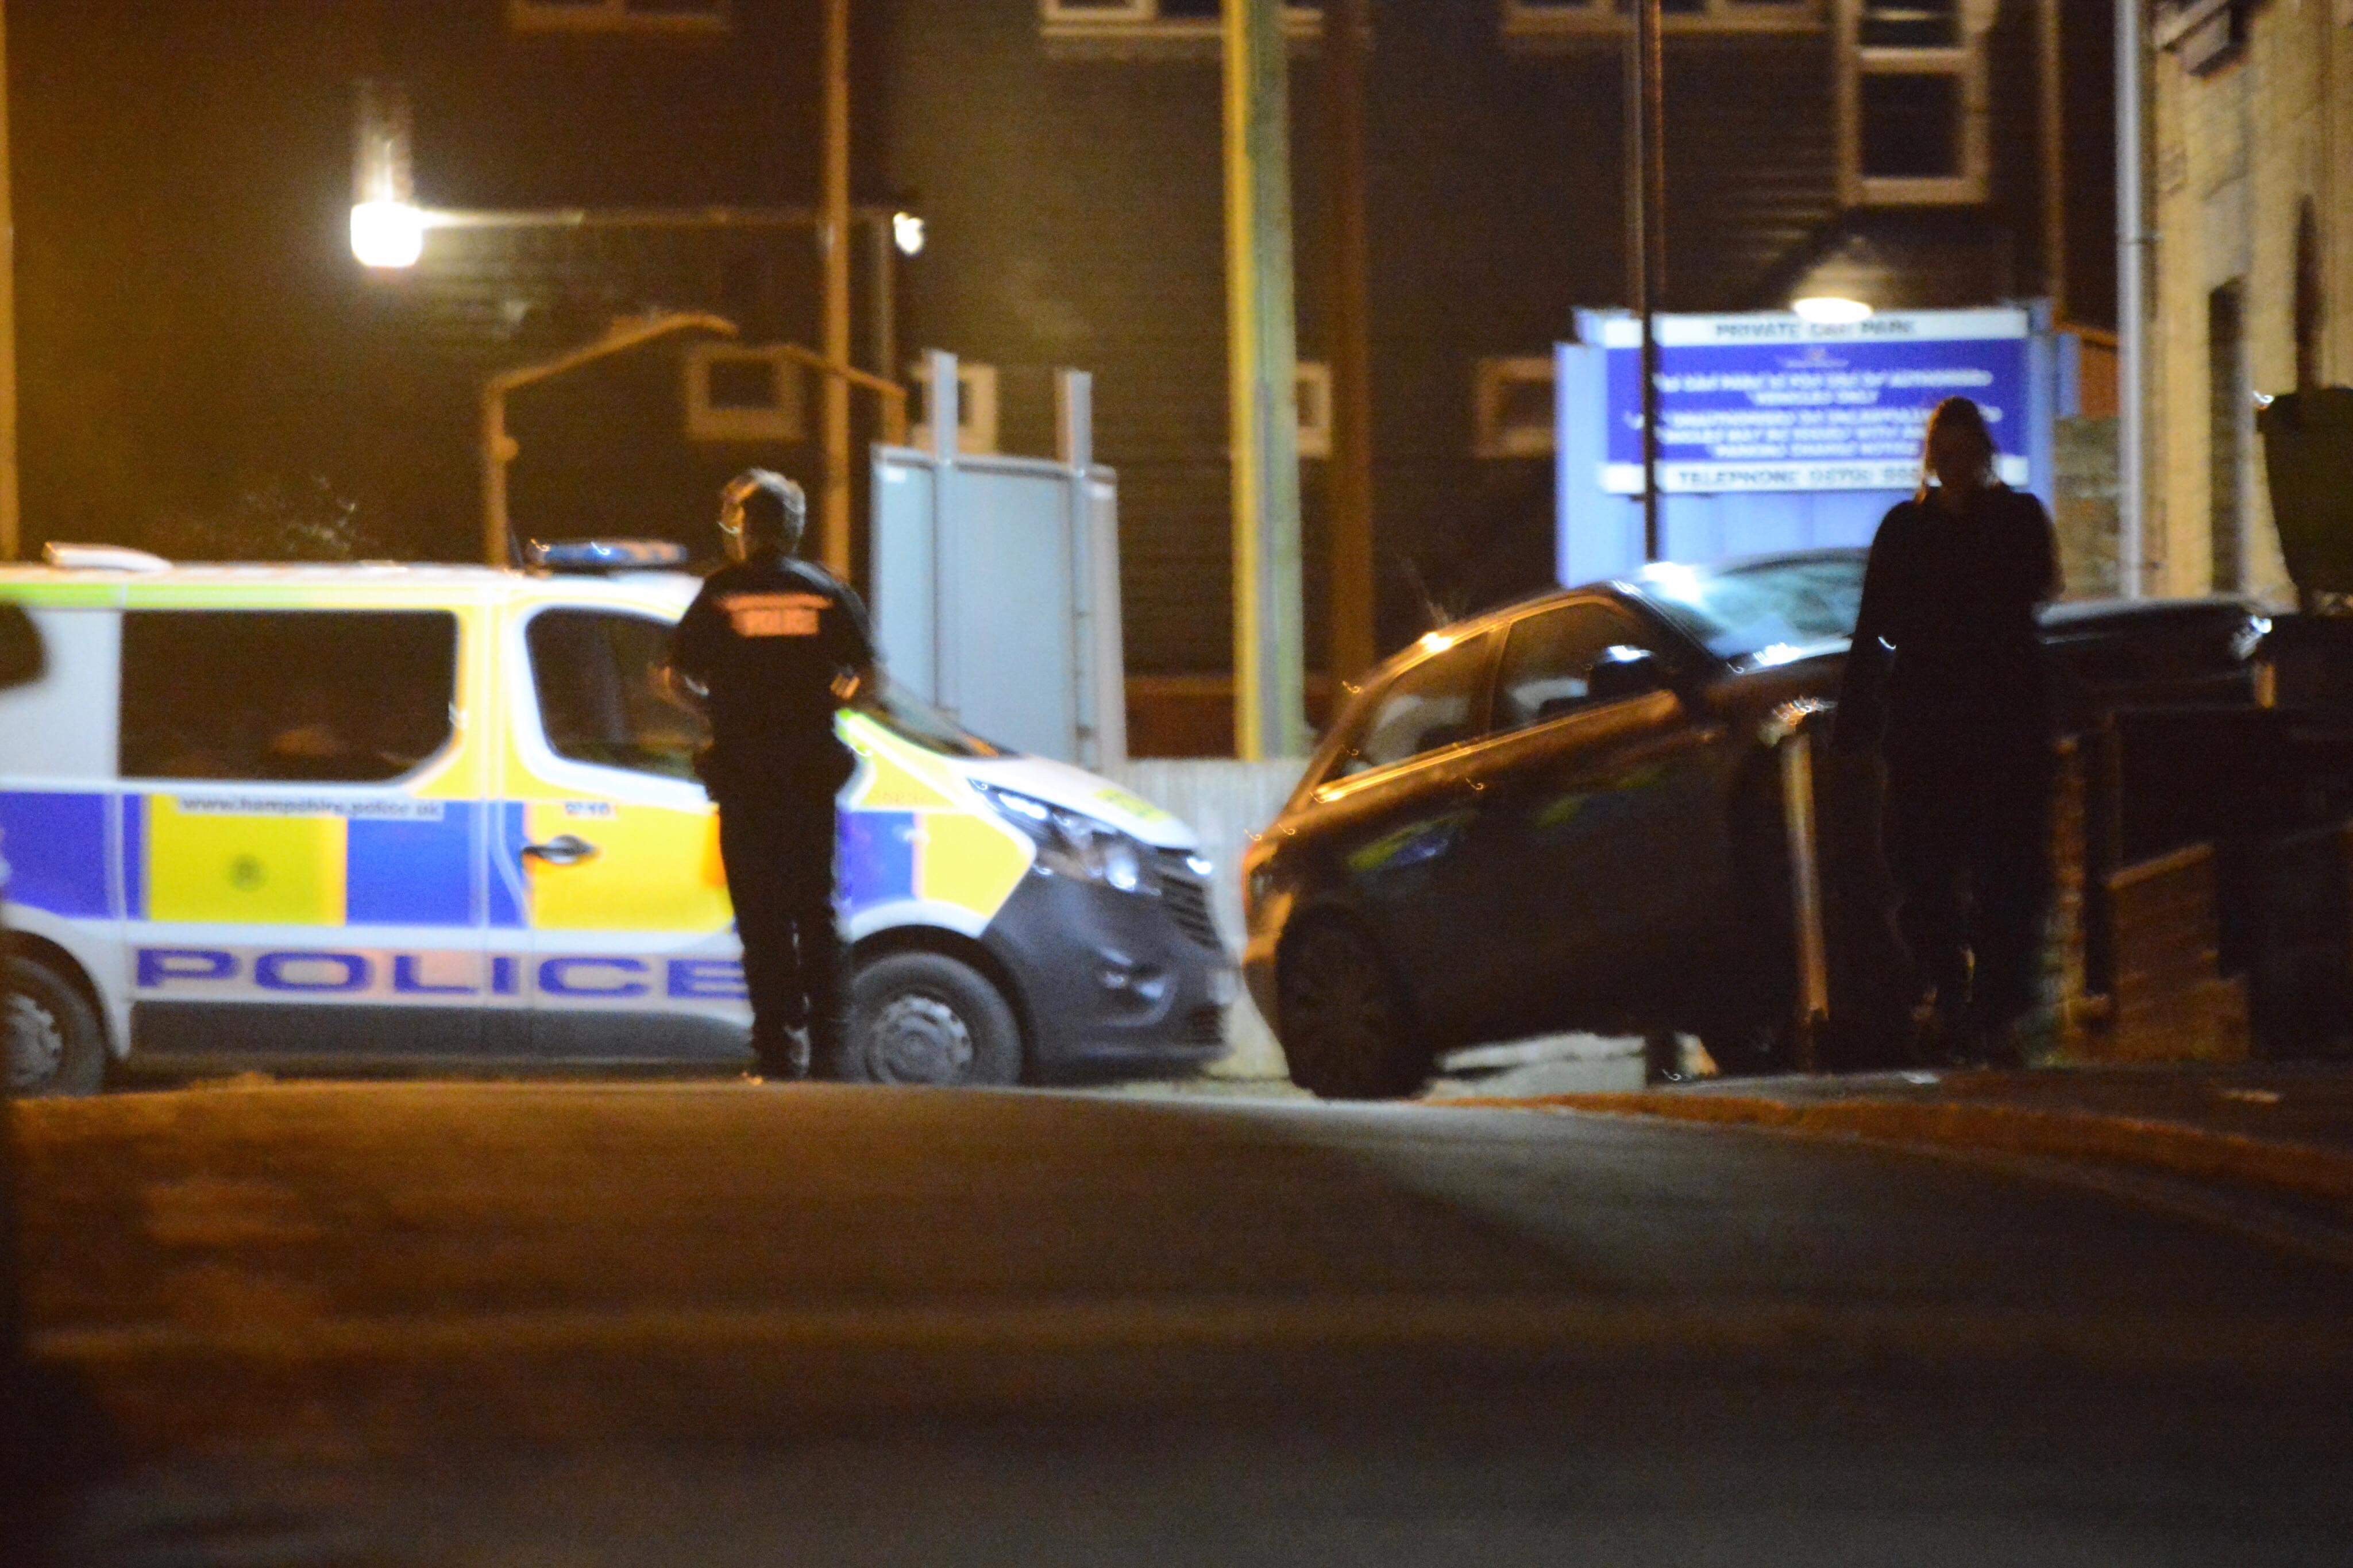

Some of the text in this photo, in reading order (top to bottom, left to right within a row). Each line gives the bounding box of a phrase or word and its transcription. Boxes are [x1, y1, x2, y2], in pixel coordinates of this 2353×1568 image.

[1715, 322, 1799, 337] PRIVATE
[1860, 319, 1914, 334] PARK
[1678, 469, 1799, 484] TELEPHONE
[136, 948, 749, 1001] POLICE
